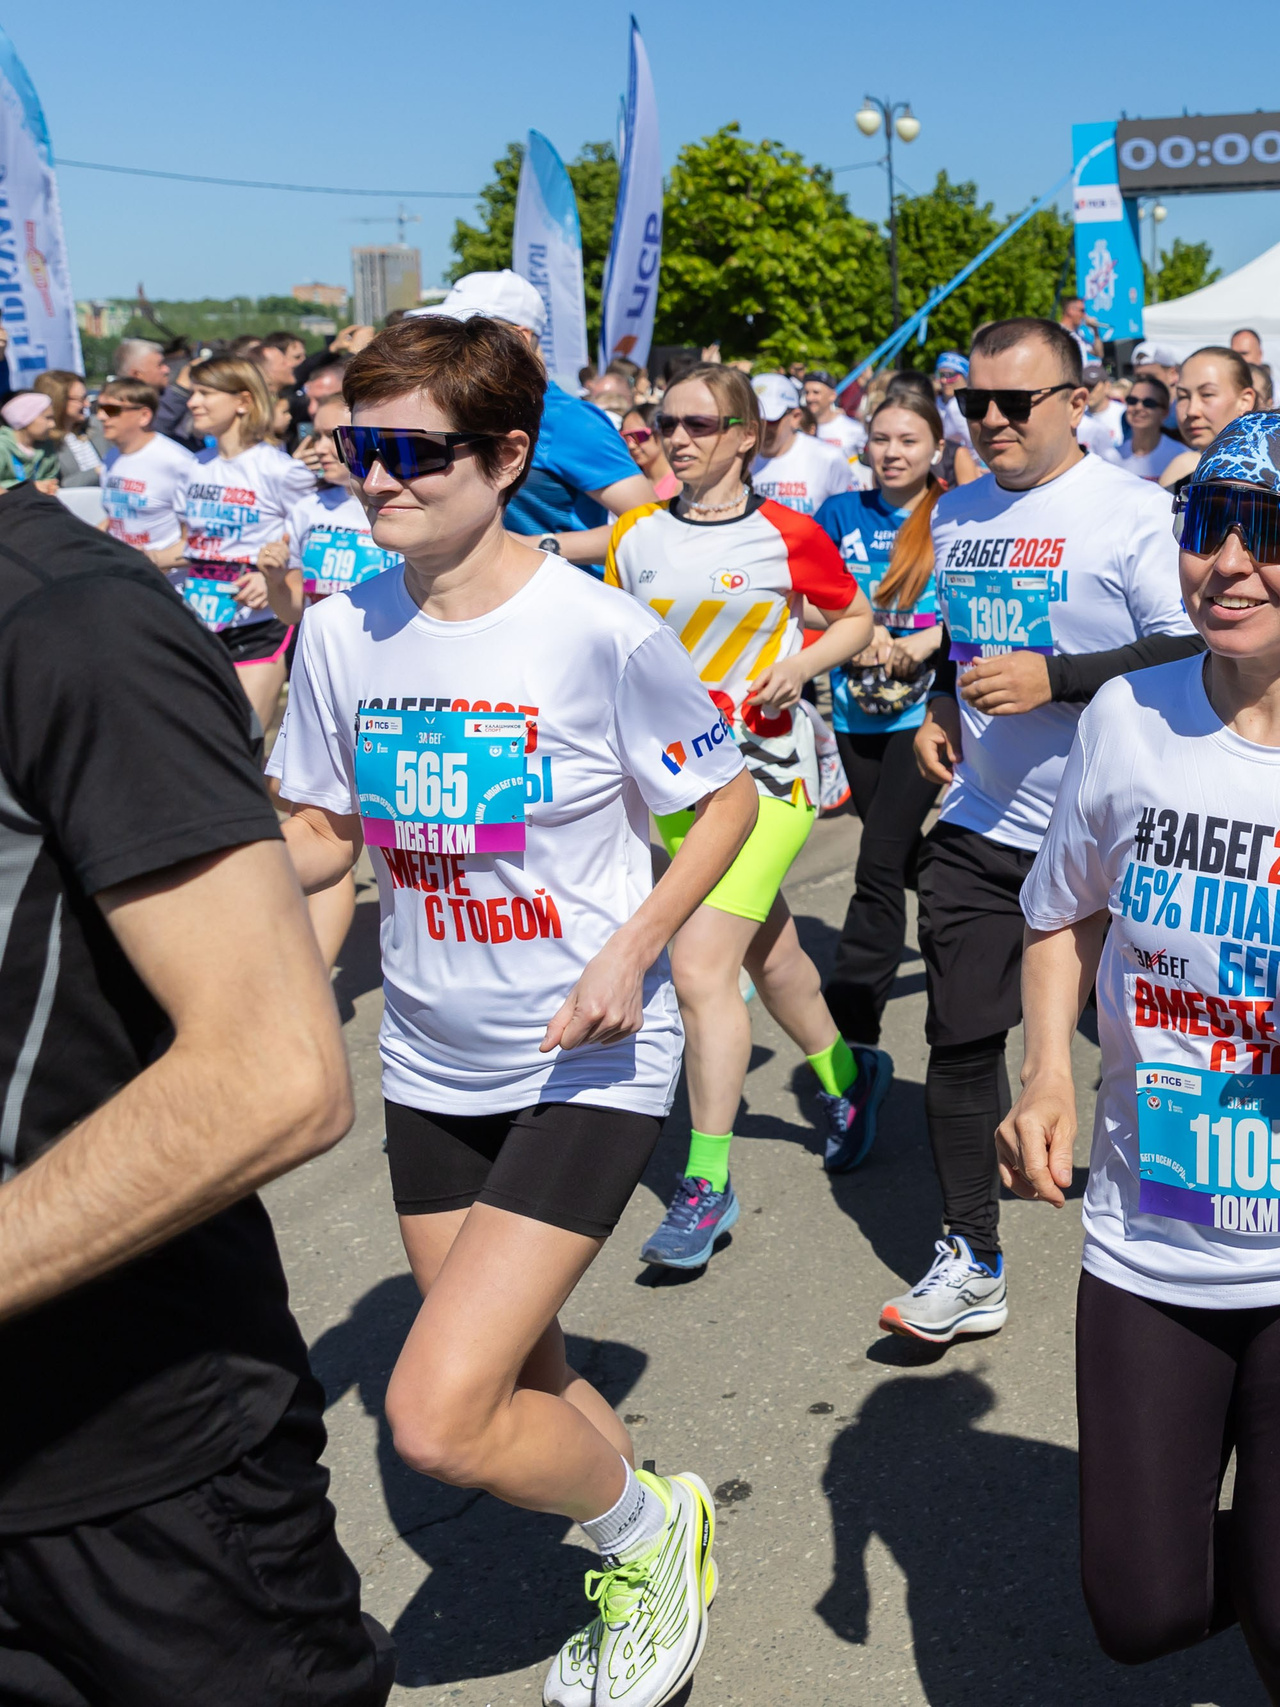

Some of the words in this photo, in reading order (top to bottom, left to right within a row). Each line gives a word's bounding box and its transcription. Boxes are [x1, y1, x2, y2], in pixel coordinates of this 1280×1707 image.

[321, 547, 357, 580] 519
[945, 538, 1066, 568] #ЗАБЕГ2025
[968, 596, 1024, 642] 1302
[374, 721, 389, 730] ПСБ
[396, 750, 468, 819] 565
[394, 821, 426, 852] ПСБ
[428, 824, 440, 853] 5
[1119, 861, 1183, 929] 45%
[425, 895, 446, 941] С
[448, 888, 563, 944] ТОБОЙ
[1135, 976, 1278, 1042] ВМЕСТЕ
[1161, 1075, 1182, 1087] ПСБ
[1211, 1193, 1279, 1233] 10КМ
